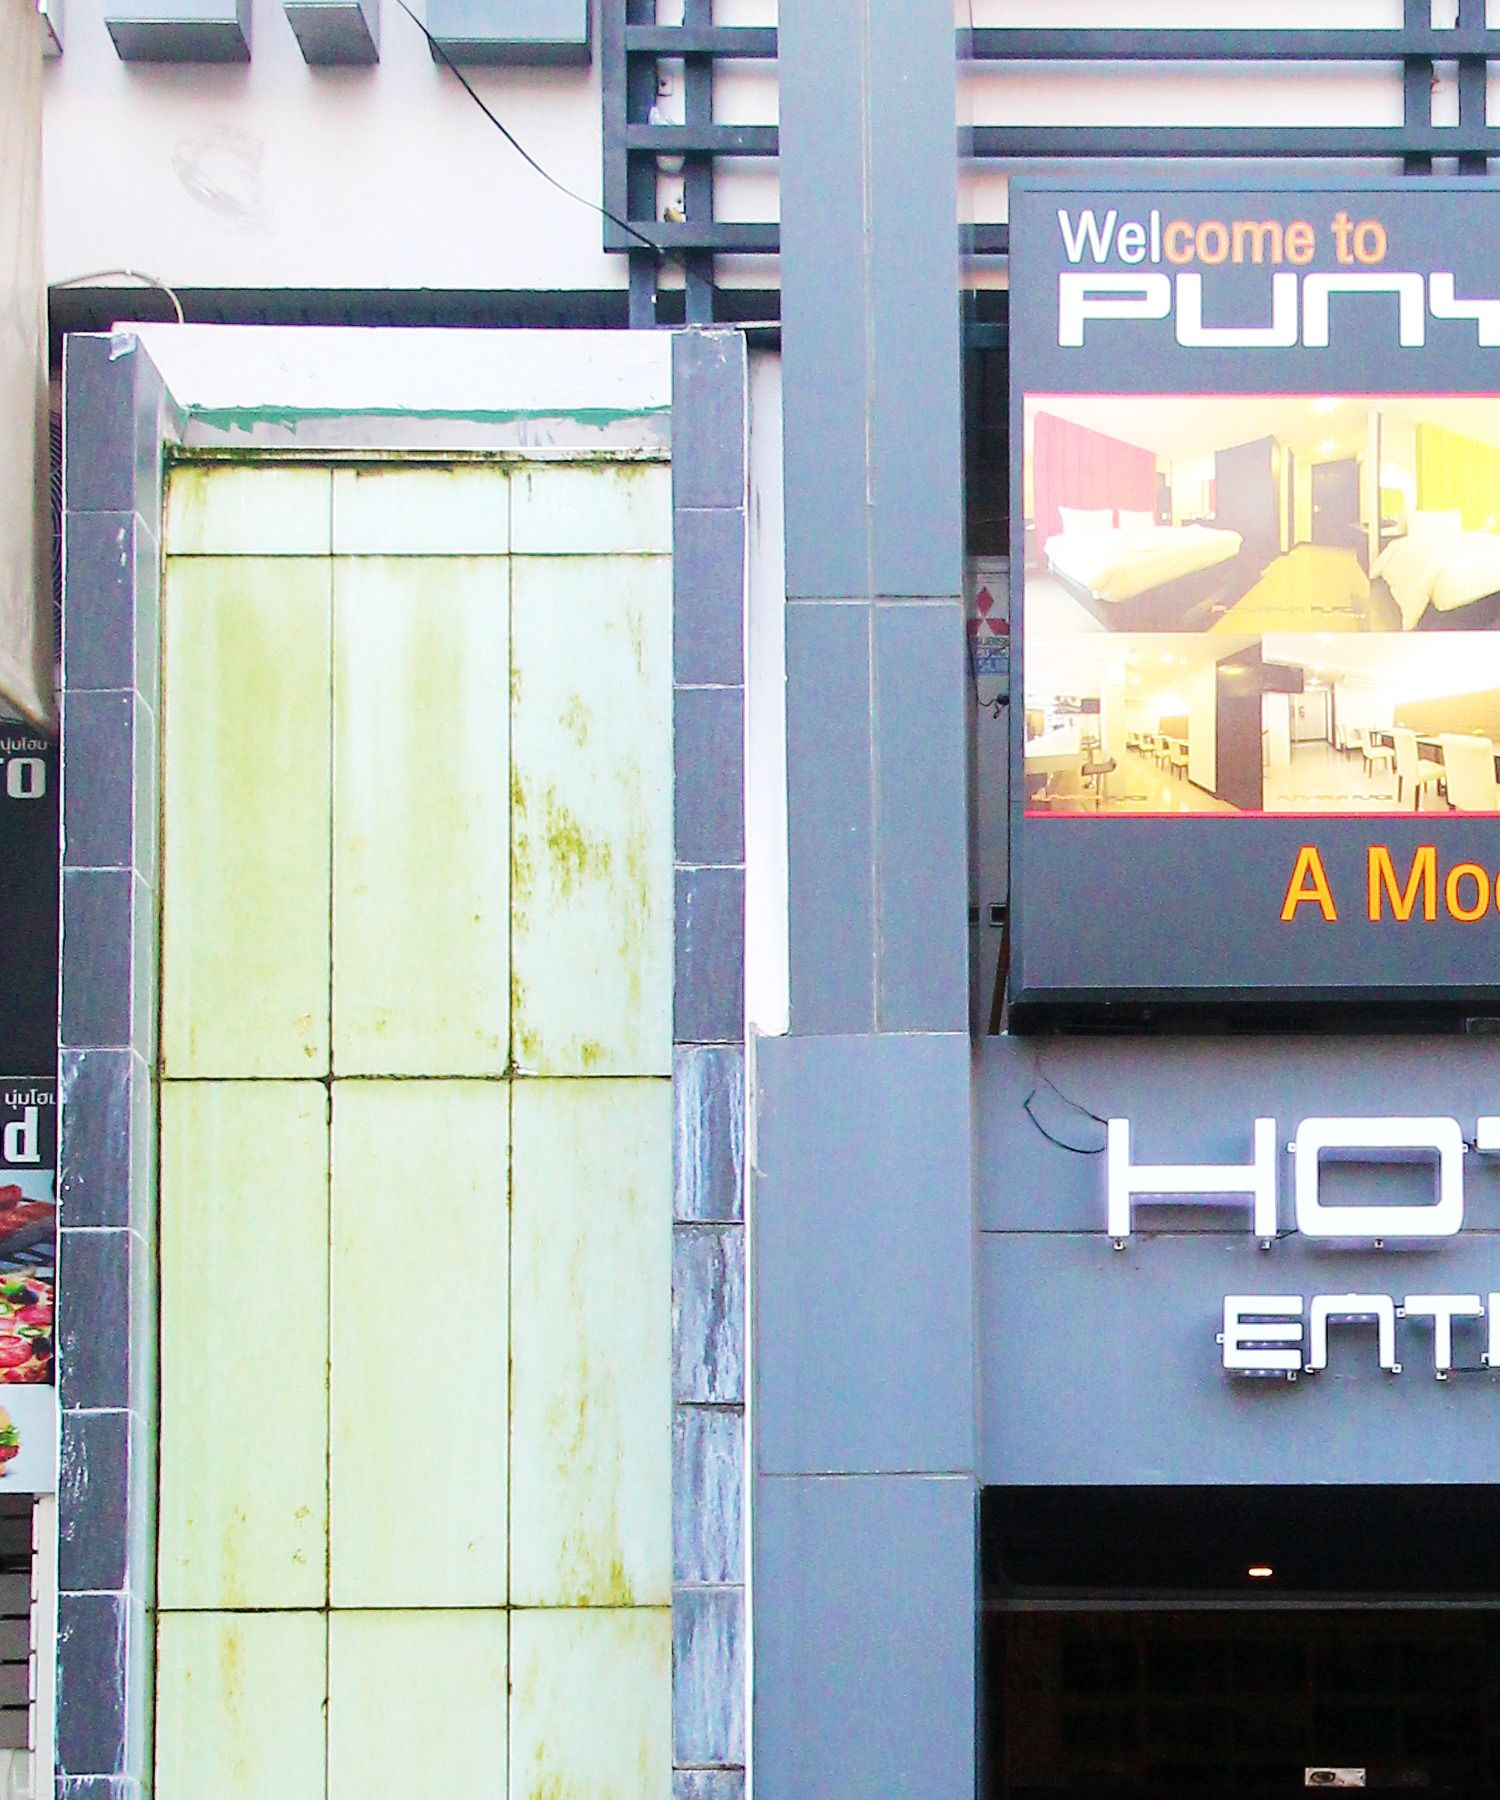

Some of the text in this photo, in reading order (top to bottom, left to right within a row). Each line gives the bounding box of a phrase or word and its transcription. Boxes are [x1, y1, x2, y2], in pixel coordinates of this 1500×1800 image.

[1057, 209, 1387, 265] Welcome to
[1281, 845, 1337, 921] A
